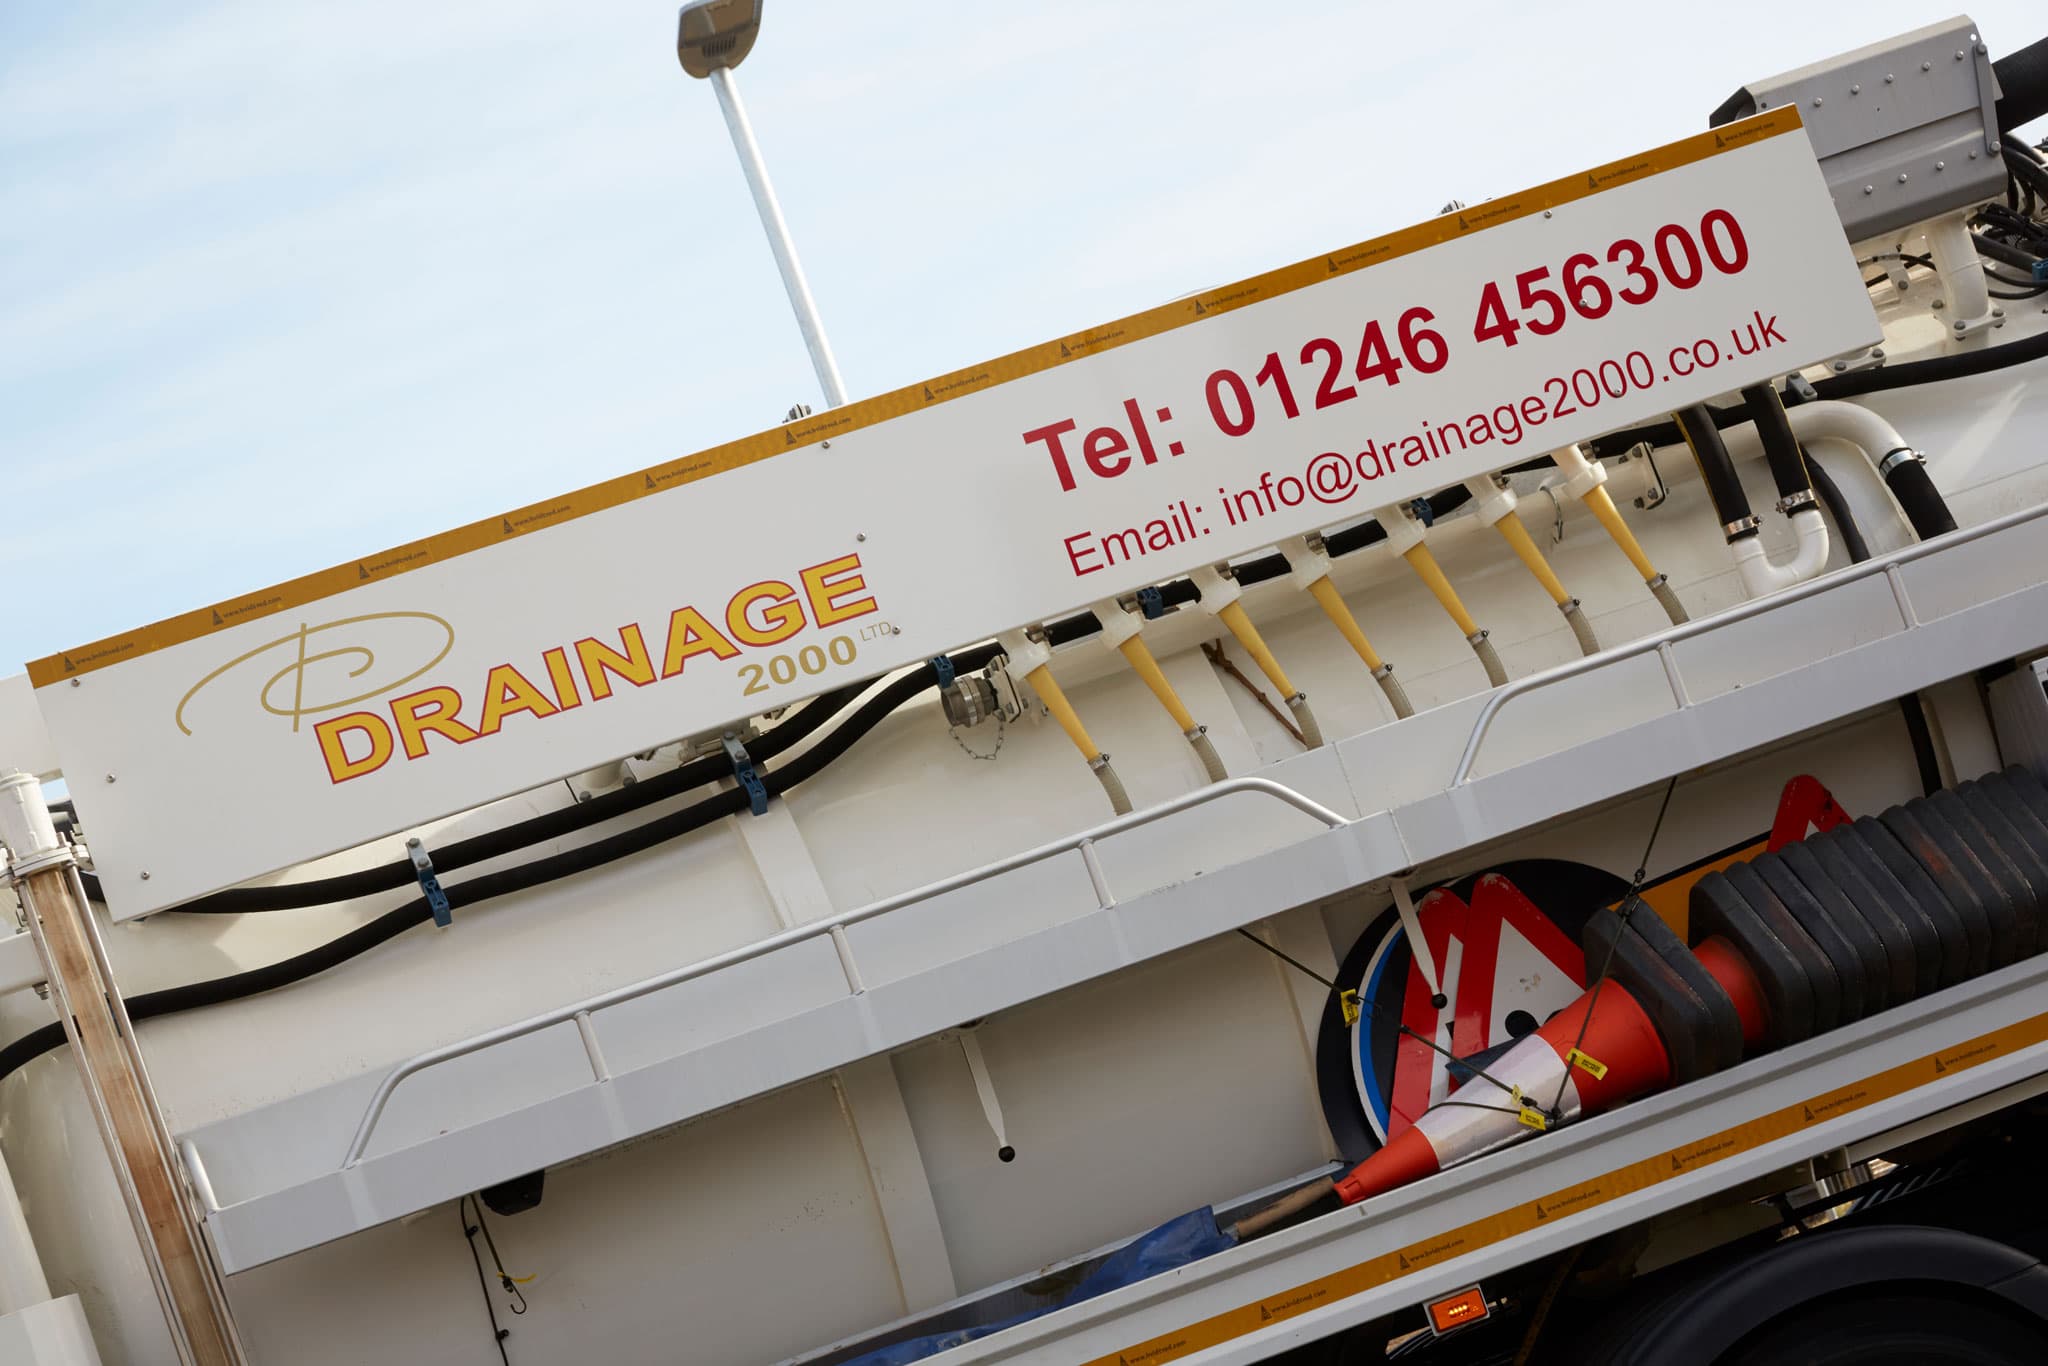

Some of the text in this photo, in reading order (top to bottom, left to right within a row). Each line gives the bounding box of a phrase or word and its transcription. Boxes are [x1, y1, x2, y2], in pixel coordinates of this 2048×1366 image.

[1024, 209, 1748, 491] Tel: 01246 456300
[1064, 312, 1786, 576] Email: info@drainage2000.co.uk
[303, 553, 878, 784] DRAINAGE
[737, 636, 857, 696] 2000
[860, 621, 891, 642] LTD
